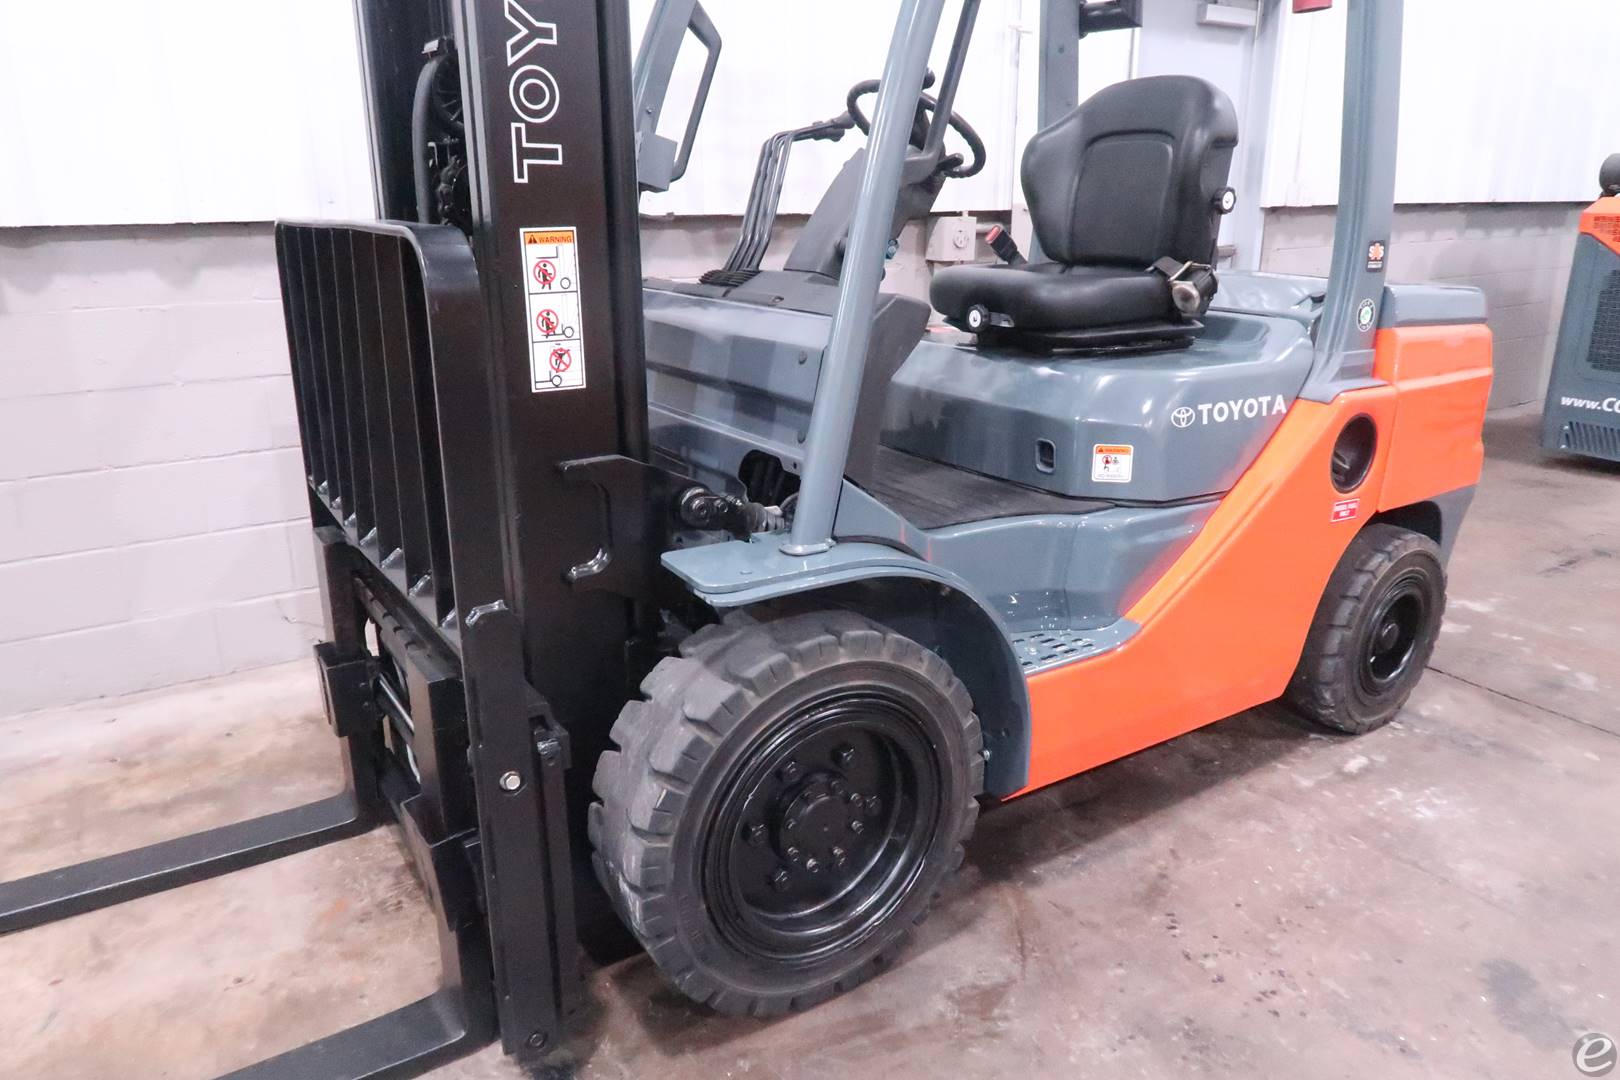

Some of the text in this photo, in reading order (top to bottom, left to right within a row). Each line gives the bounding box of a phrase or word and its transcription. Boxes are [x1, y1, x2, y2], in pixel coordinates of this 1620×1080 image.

[503, 0, 562, 183] TOY
[538, 235, 572, 244] WARNING
[1198, 394, 1287, 425] TOYOTA
